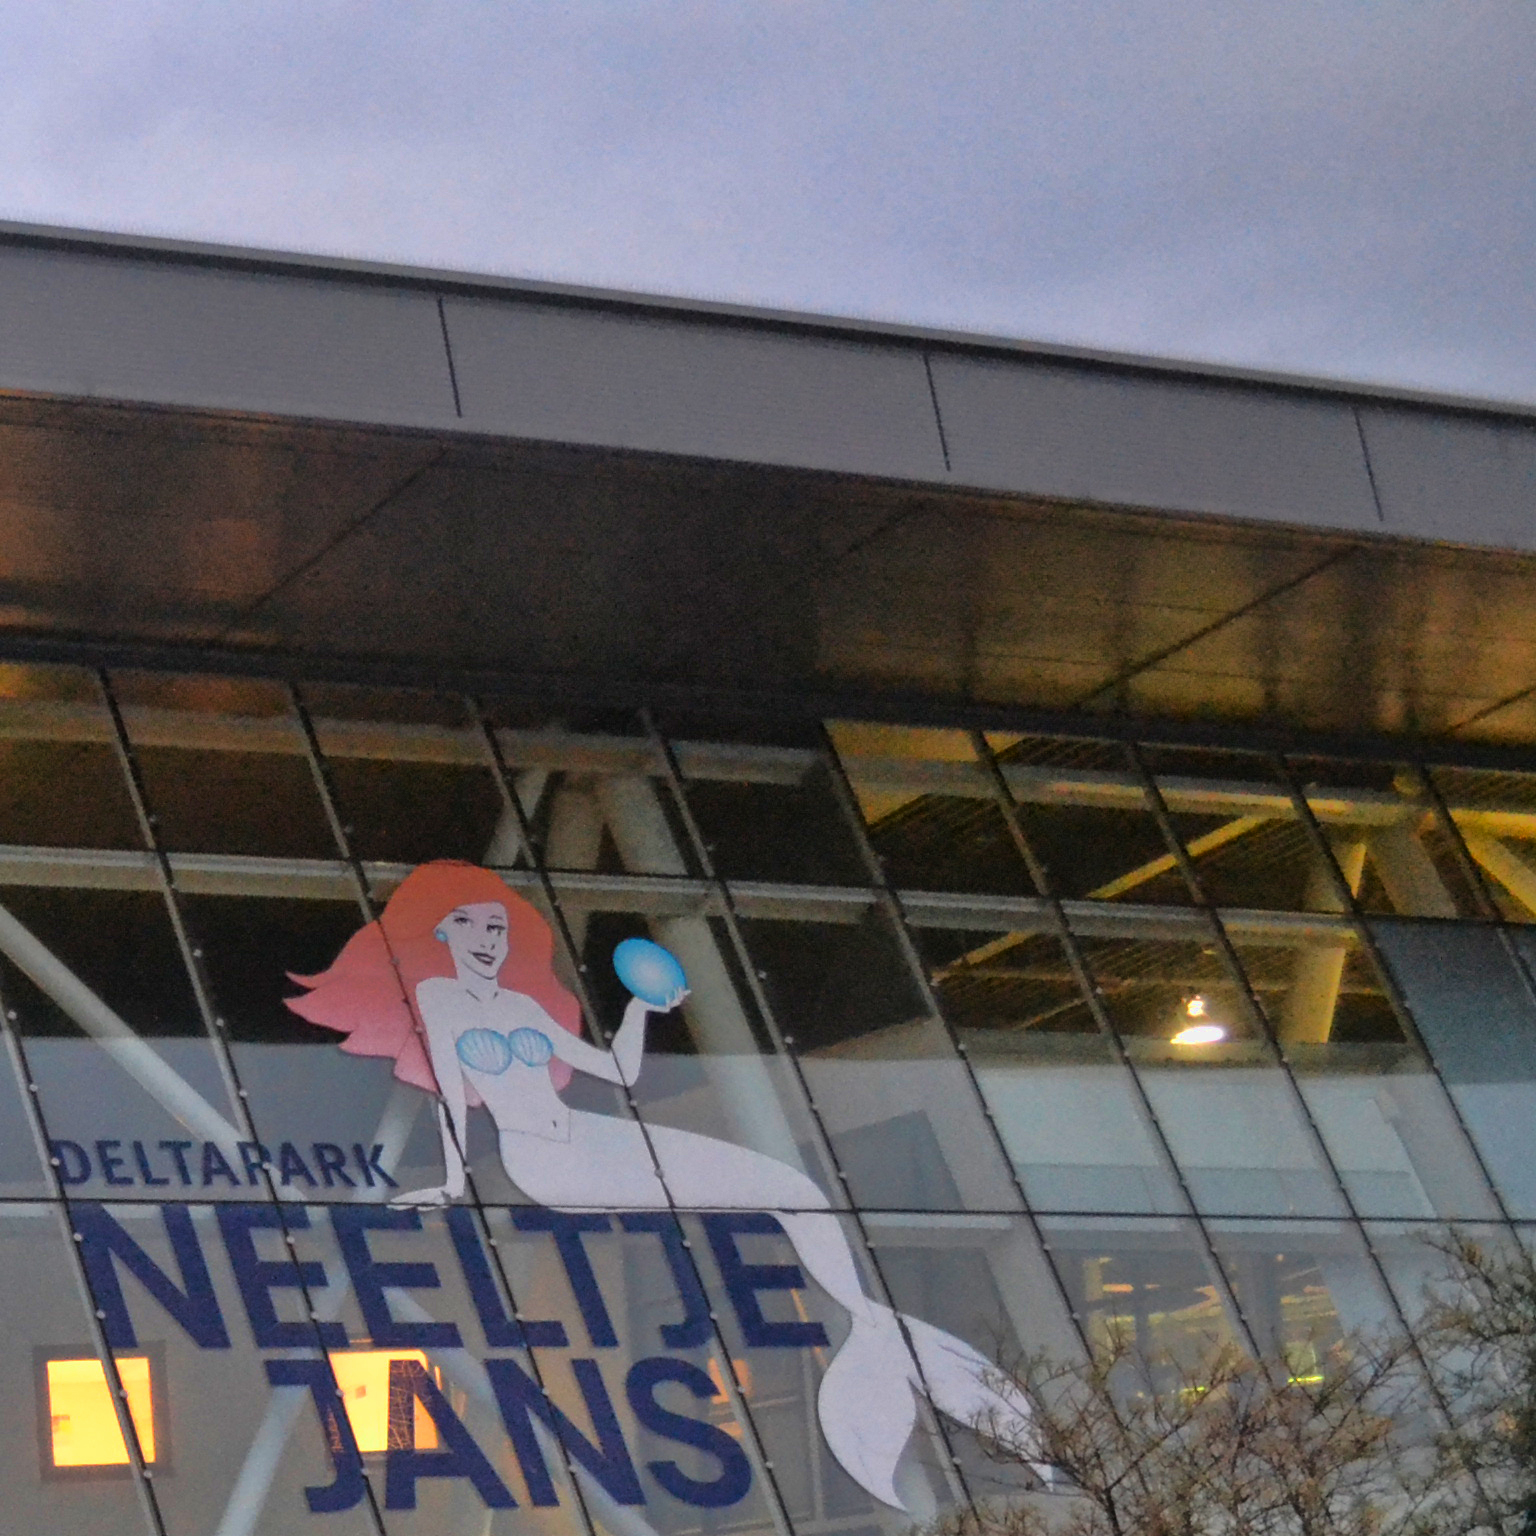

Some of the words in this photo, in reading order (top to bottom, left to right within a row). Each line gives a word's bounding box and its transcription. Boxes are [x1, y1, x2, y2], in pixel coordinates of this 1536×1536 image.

[52, 1138, 398, 1189] DELTAPARK
[71, 1203, 831, 1351] NEELTJE
[265, 1356, 752, 1513] JANS
